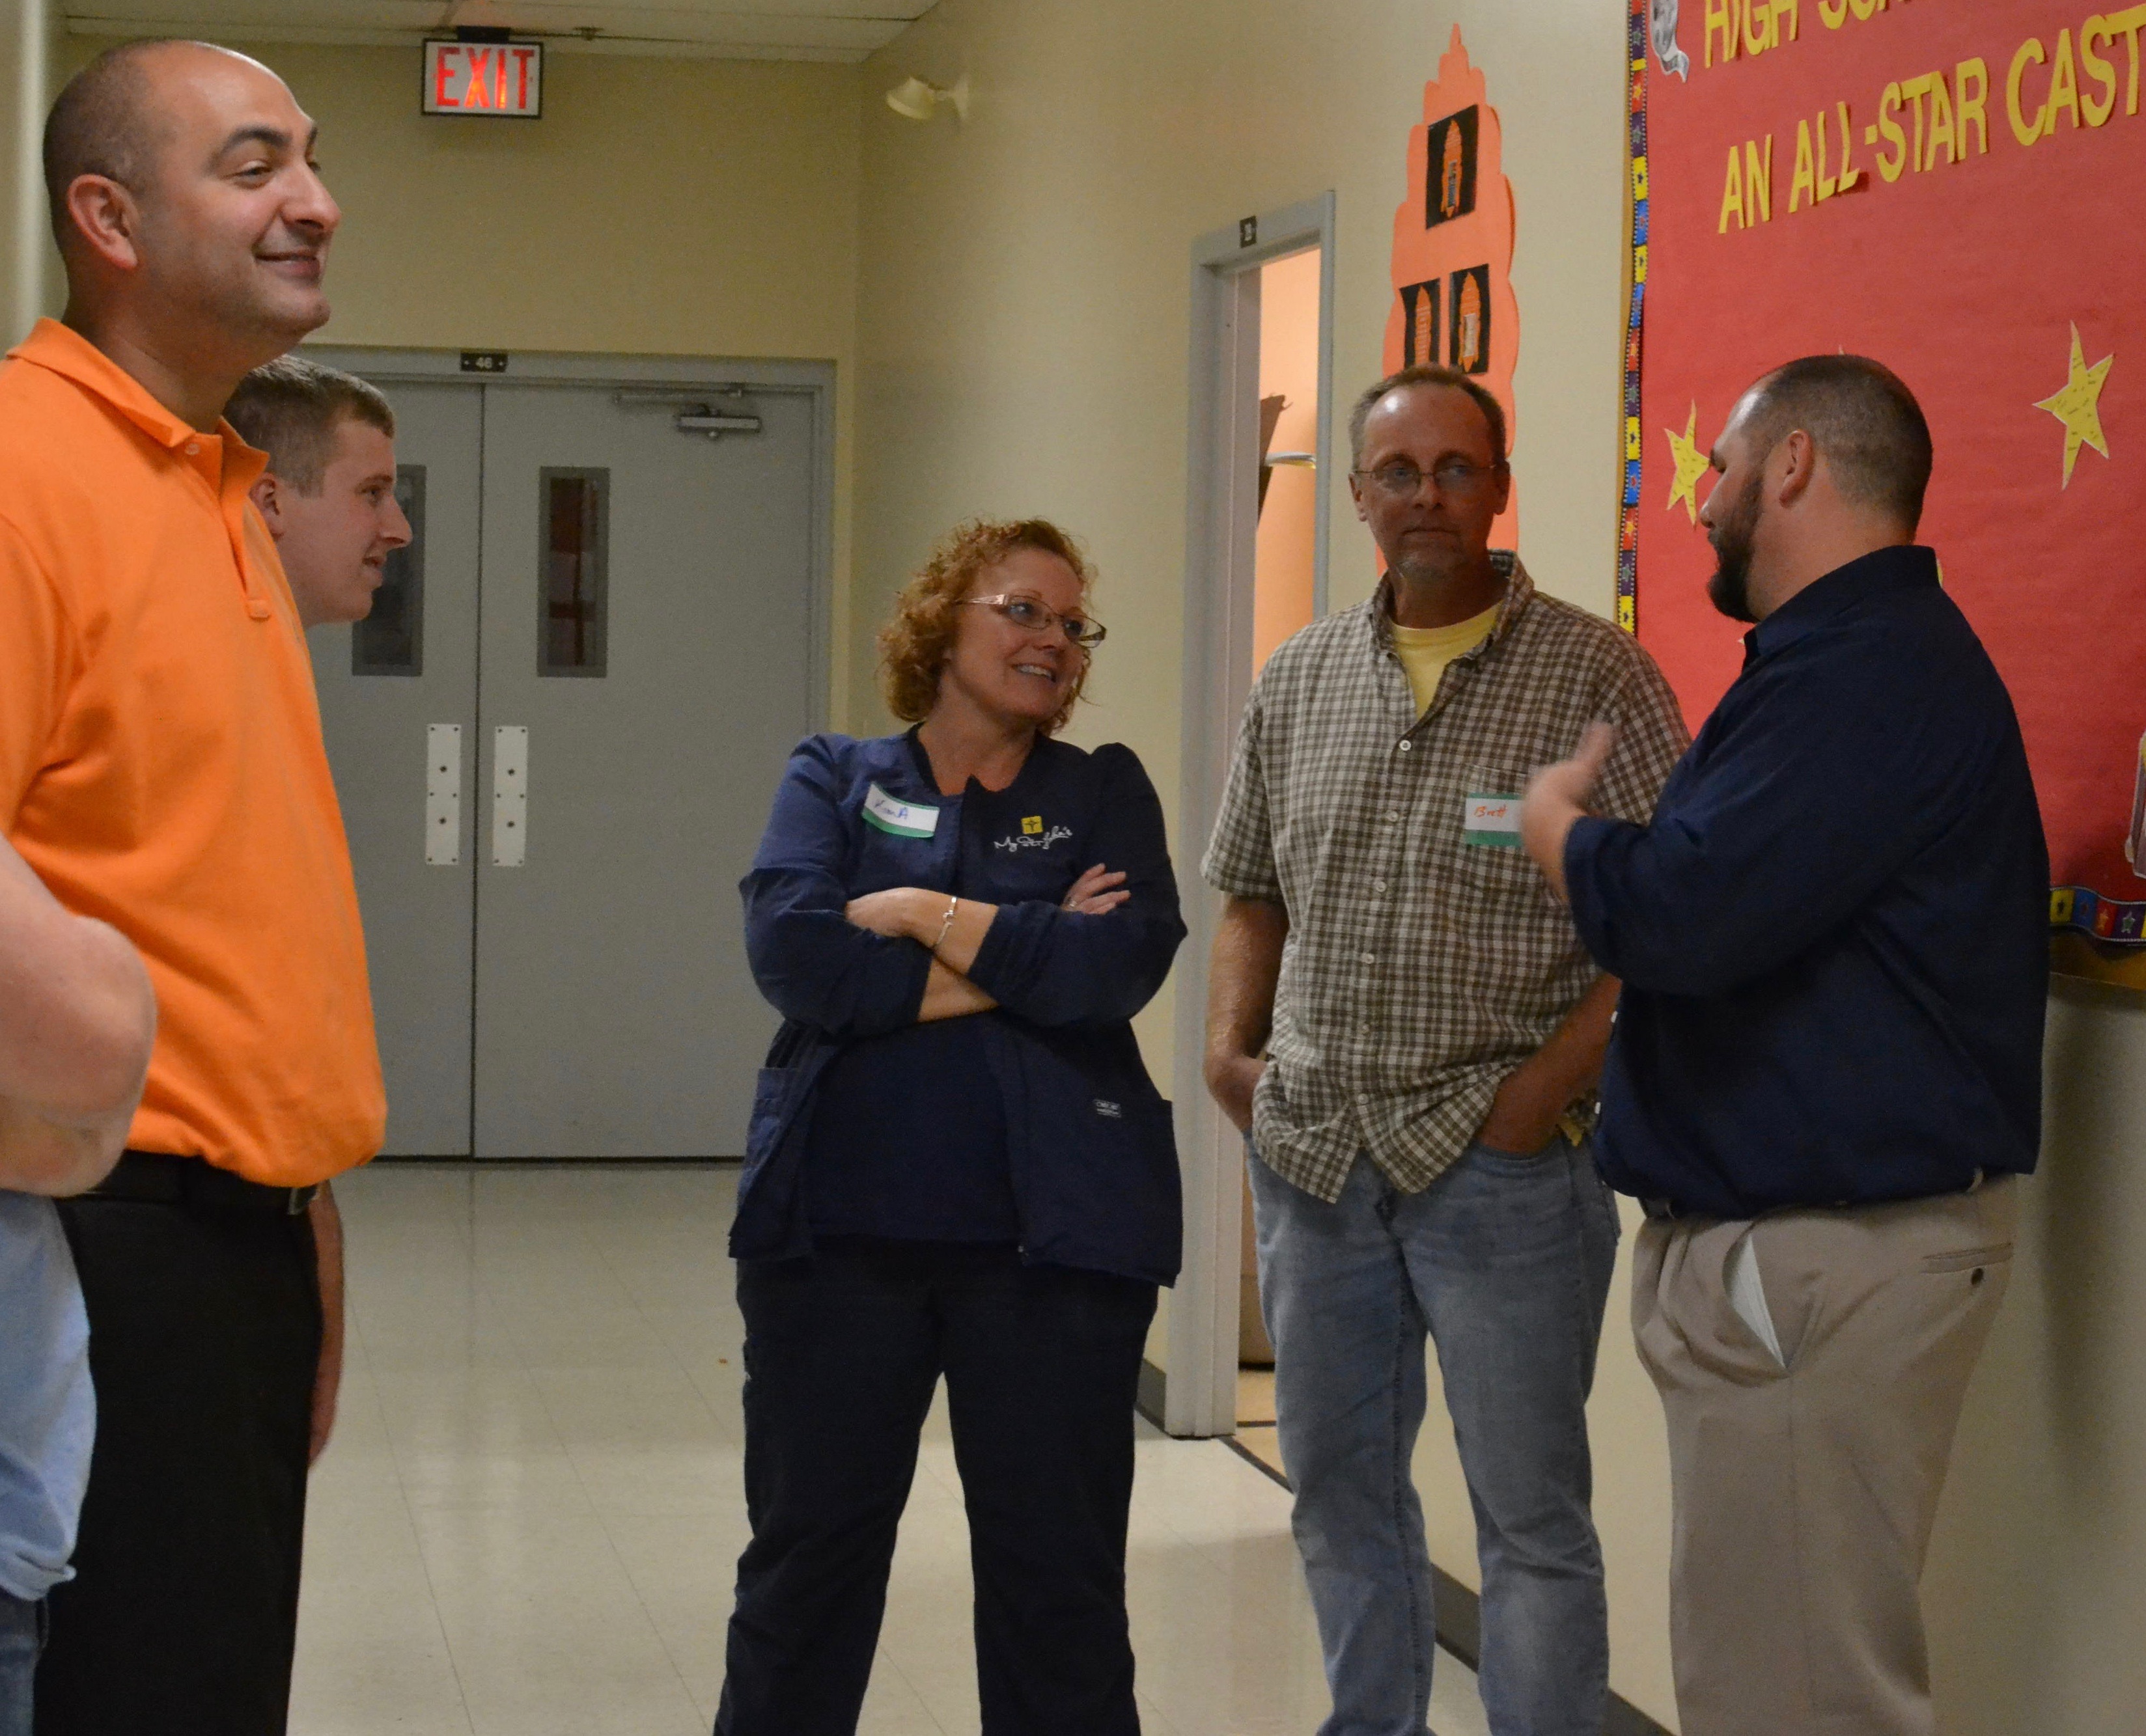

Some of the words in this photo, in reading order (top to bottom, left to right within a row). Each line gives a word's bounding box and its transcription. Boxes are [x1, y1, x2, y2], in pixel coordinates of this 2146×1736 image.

[436, 46, 535, 109] EXIT
[1718, 134, 1773, 234] AN
[1788, 57, 1988, 214] ALL-STAR
